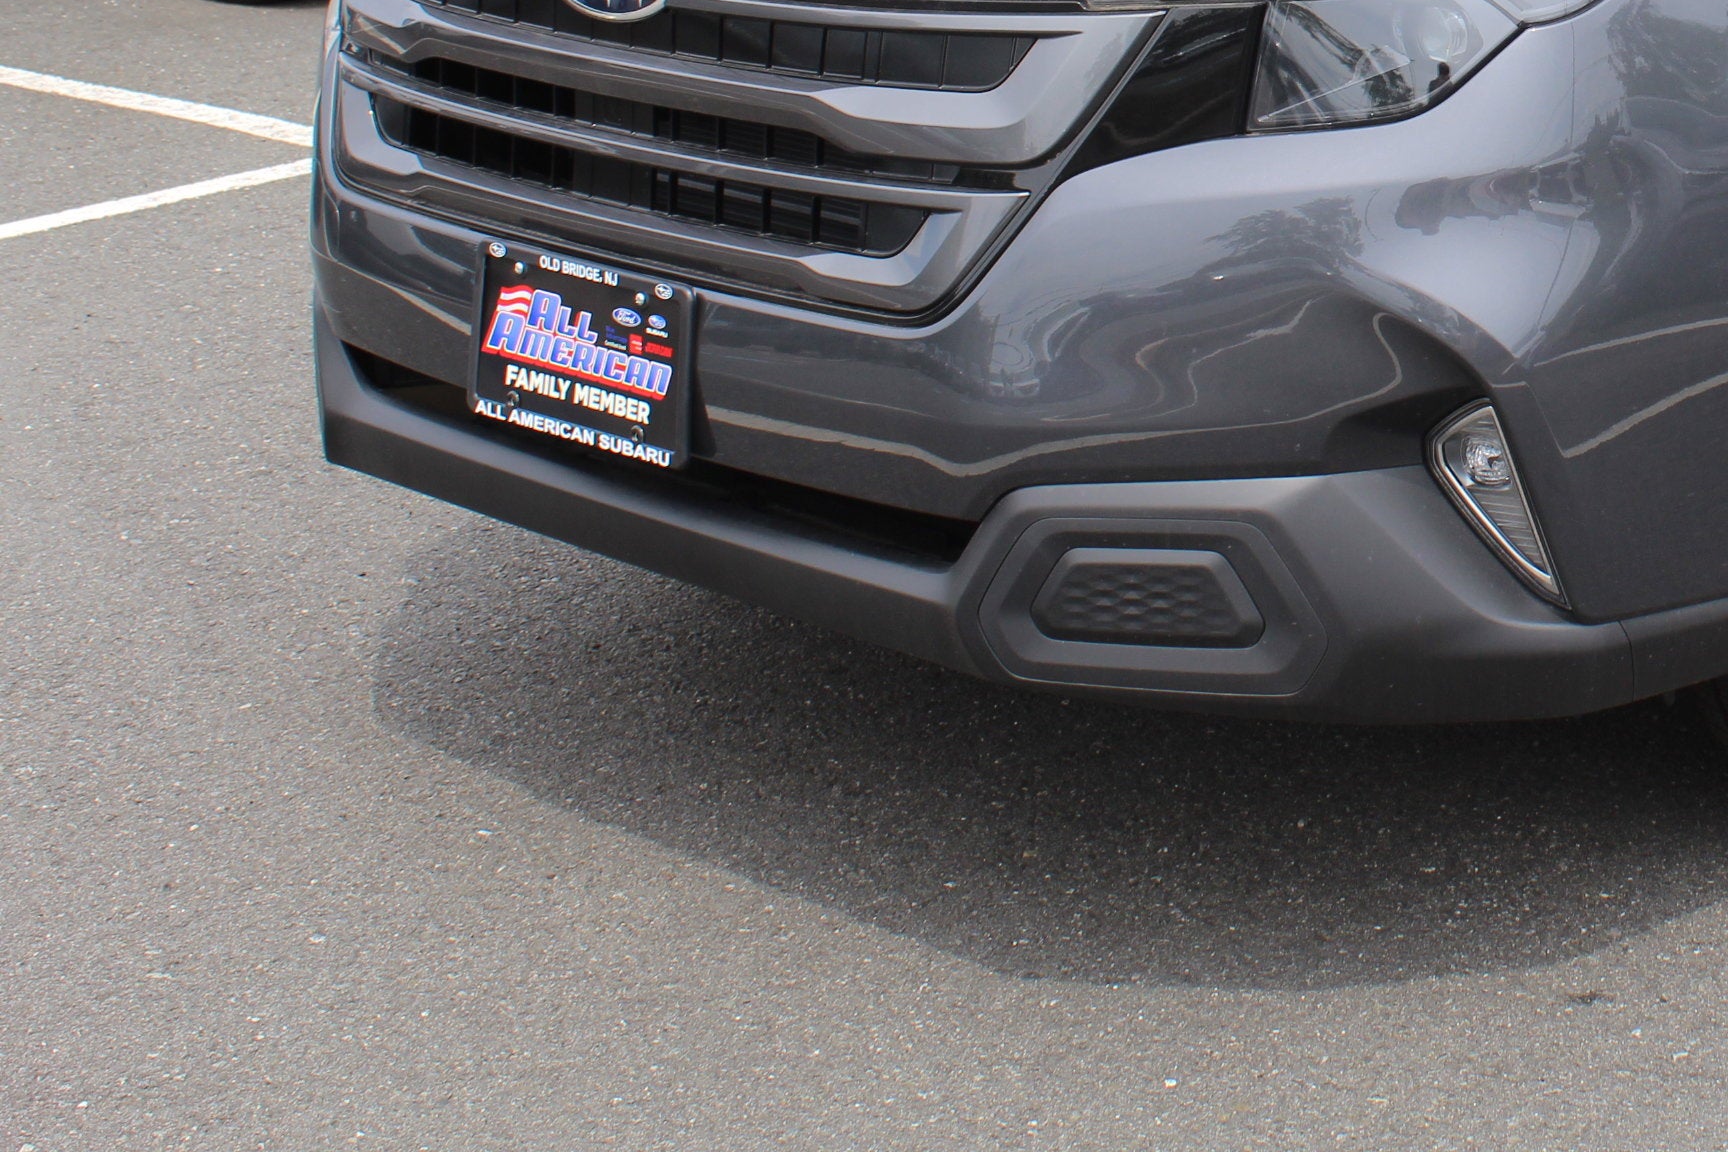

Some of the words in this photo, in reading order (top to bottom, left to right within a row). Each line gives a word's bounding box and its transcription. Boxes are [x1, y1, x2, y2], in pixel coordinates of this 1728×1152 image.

[539, 255, 561, 273] OLD
[561, 260, 603, 283] BRIDGE,
[603, 271, 619, 287] NJ
[505, 364, 571, 401] FAMILY
[573, 382, 650, 424] MEMBER
[475, 400, 506, 421] ALL
[508, 408, 595, 446] AMERICAN
[598, 434, 670, 468] SUBARU
